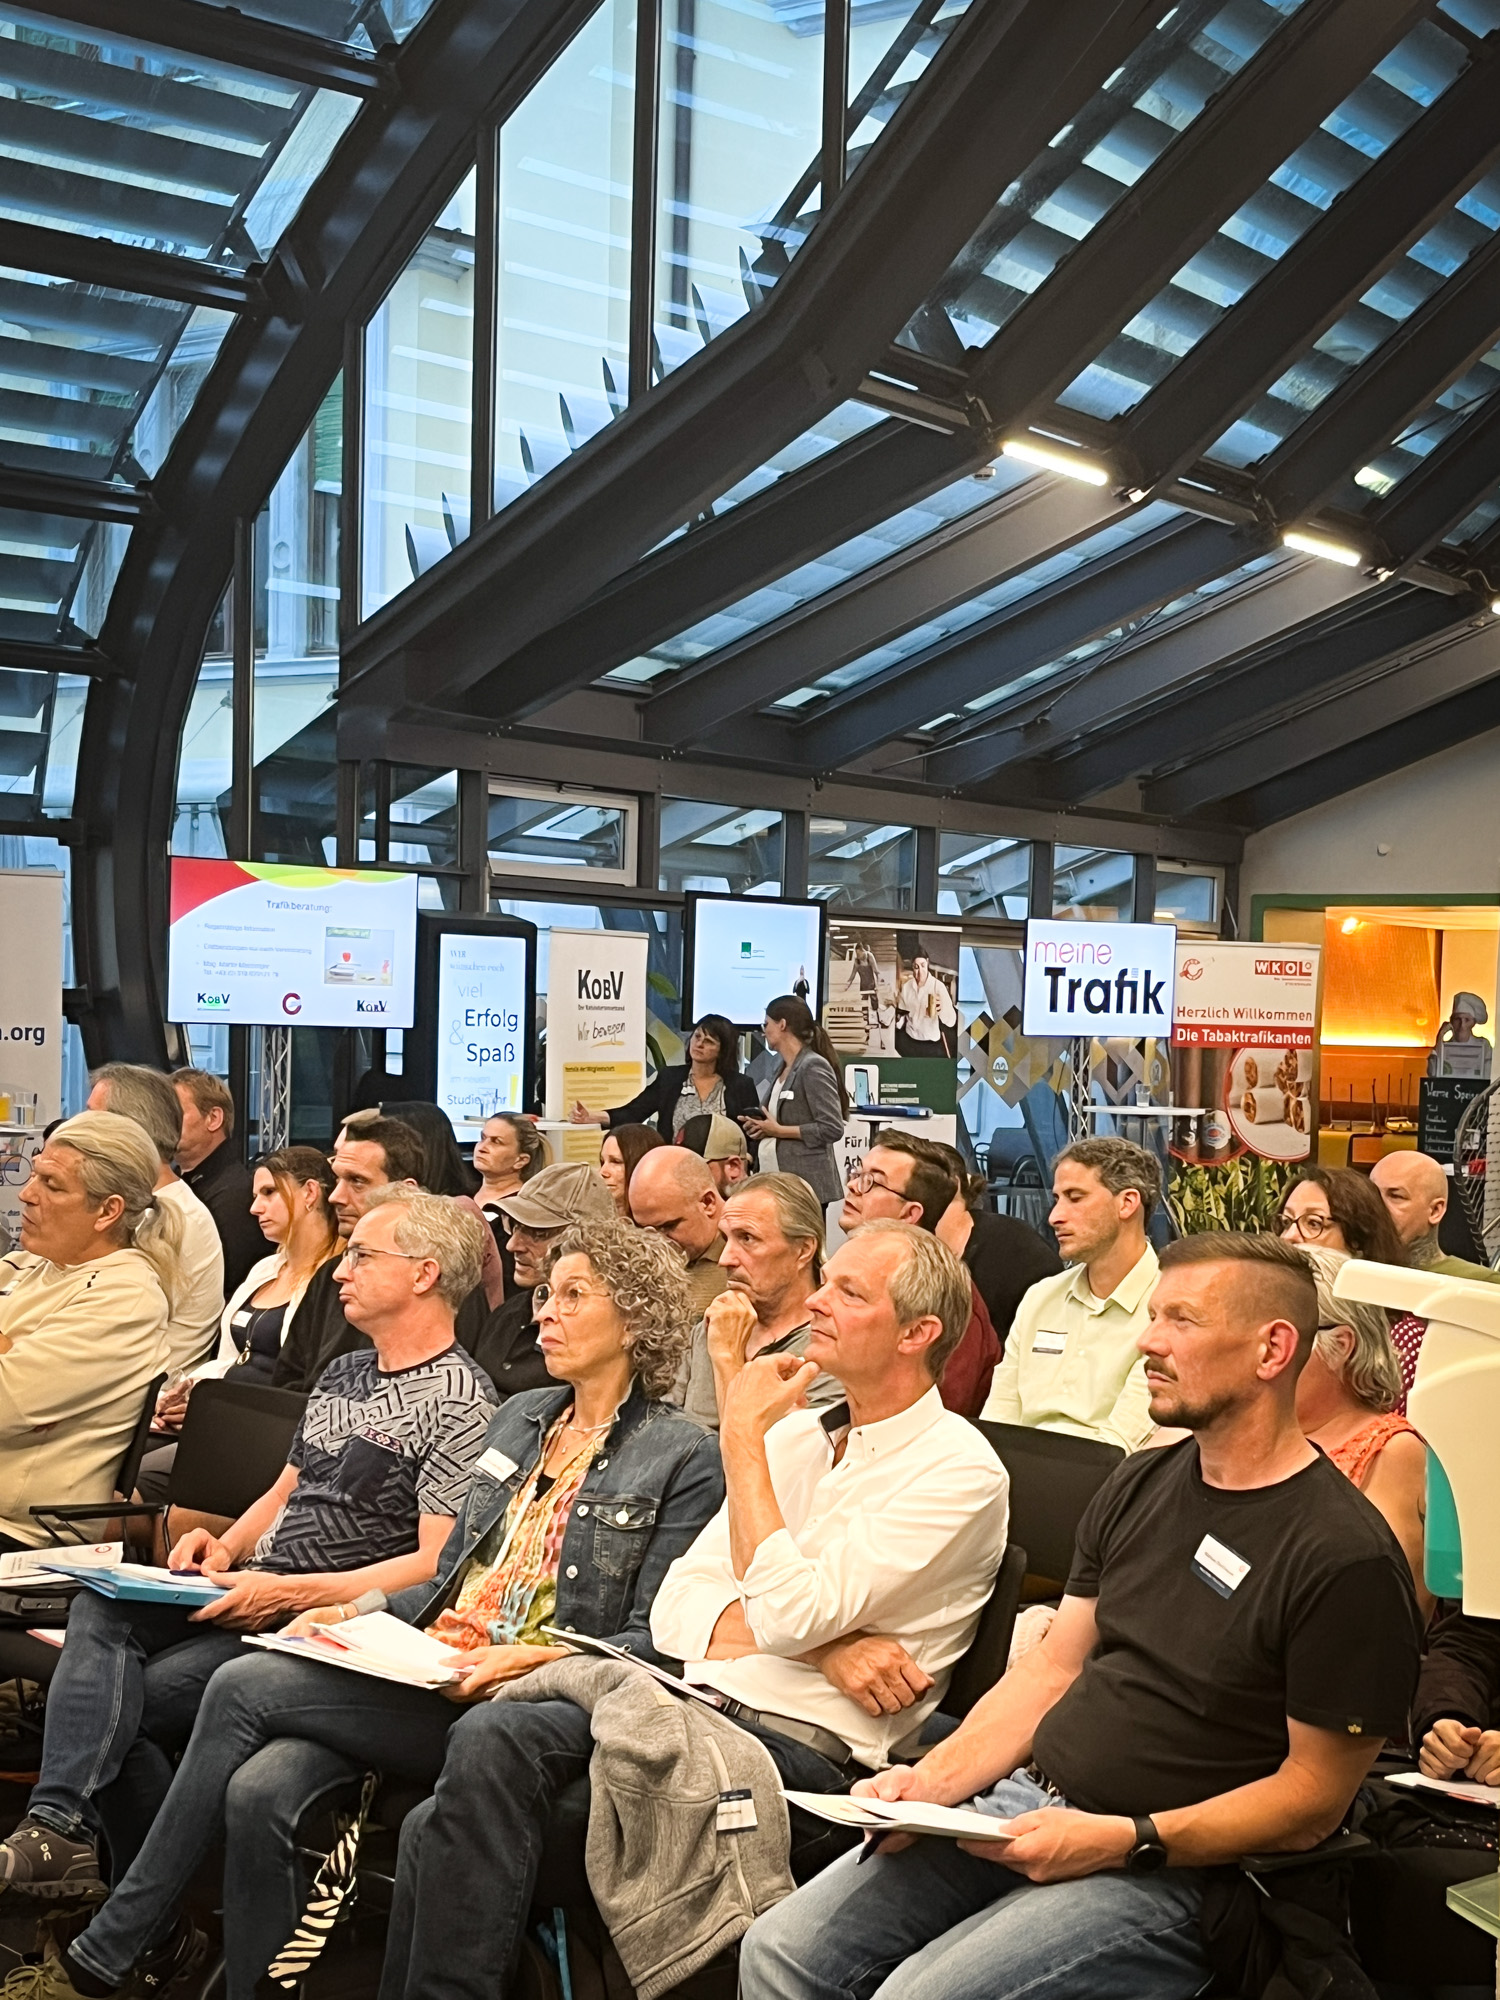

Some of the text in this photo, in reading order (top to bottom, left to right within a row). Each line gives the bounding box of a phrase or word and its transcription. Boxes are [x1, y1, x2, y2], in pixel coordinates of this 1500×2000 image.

[1034, 941, 1112, 965] meine
[457, 982, 483, 998] viel
[1044, 967, 1166, 1015] Trafik
[465, 1008, 518, 1032] Erfolg
[1176, 1006, 1313, 1021] Herzlich Willkommen
[0, 1026, 46, 1046] .org
[1176, 1028, 1312, 1045] Die Tabaktrafikanten
[466, 1042, 516, 1068] Spaß
[844, 1136, 863, 1148] Für
